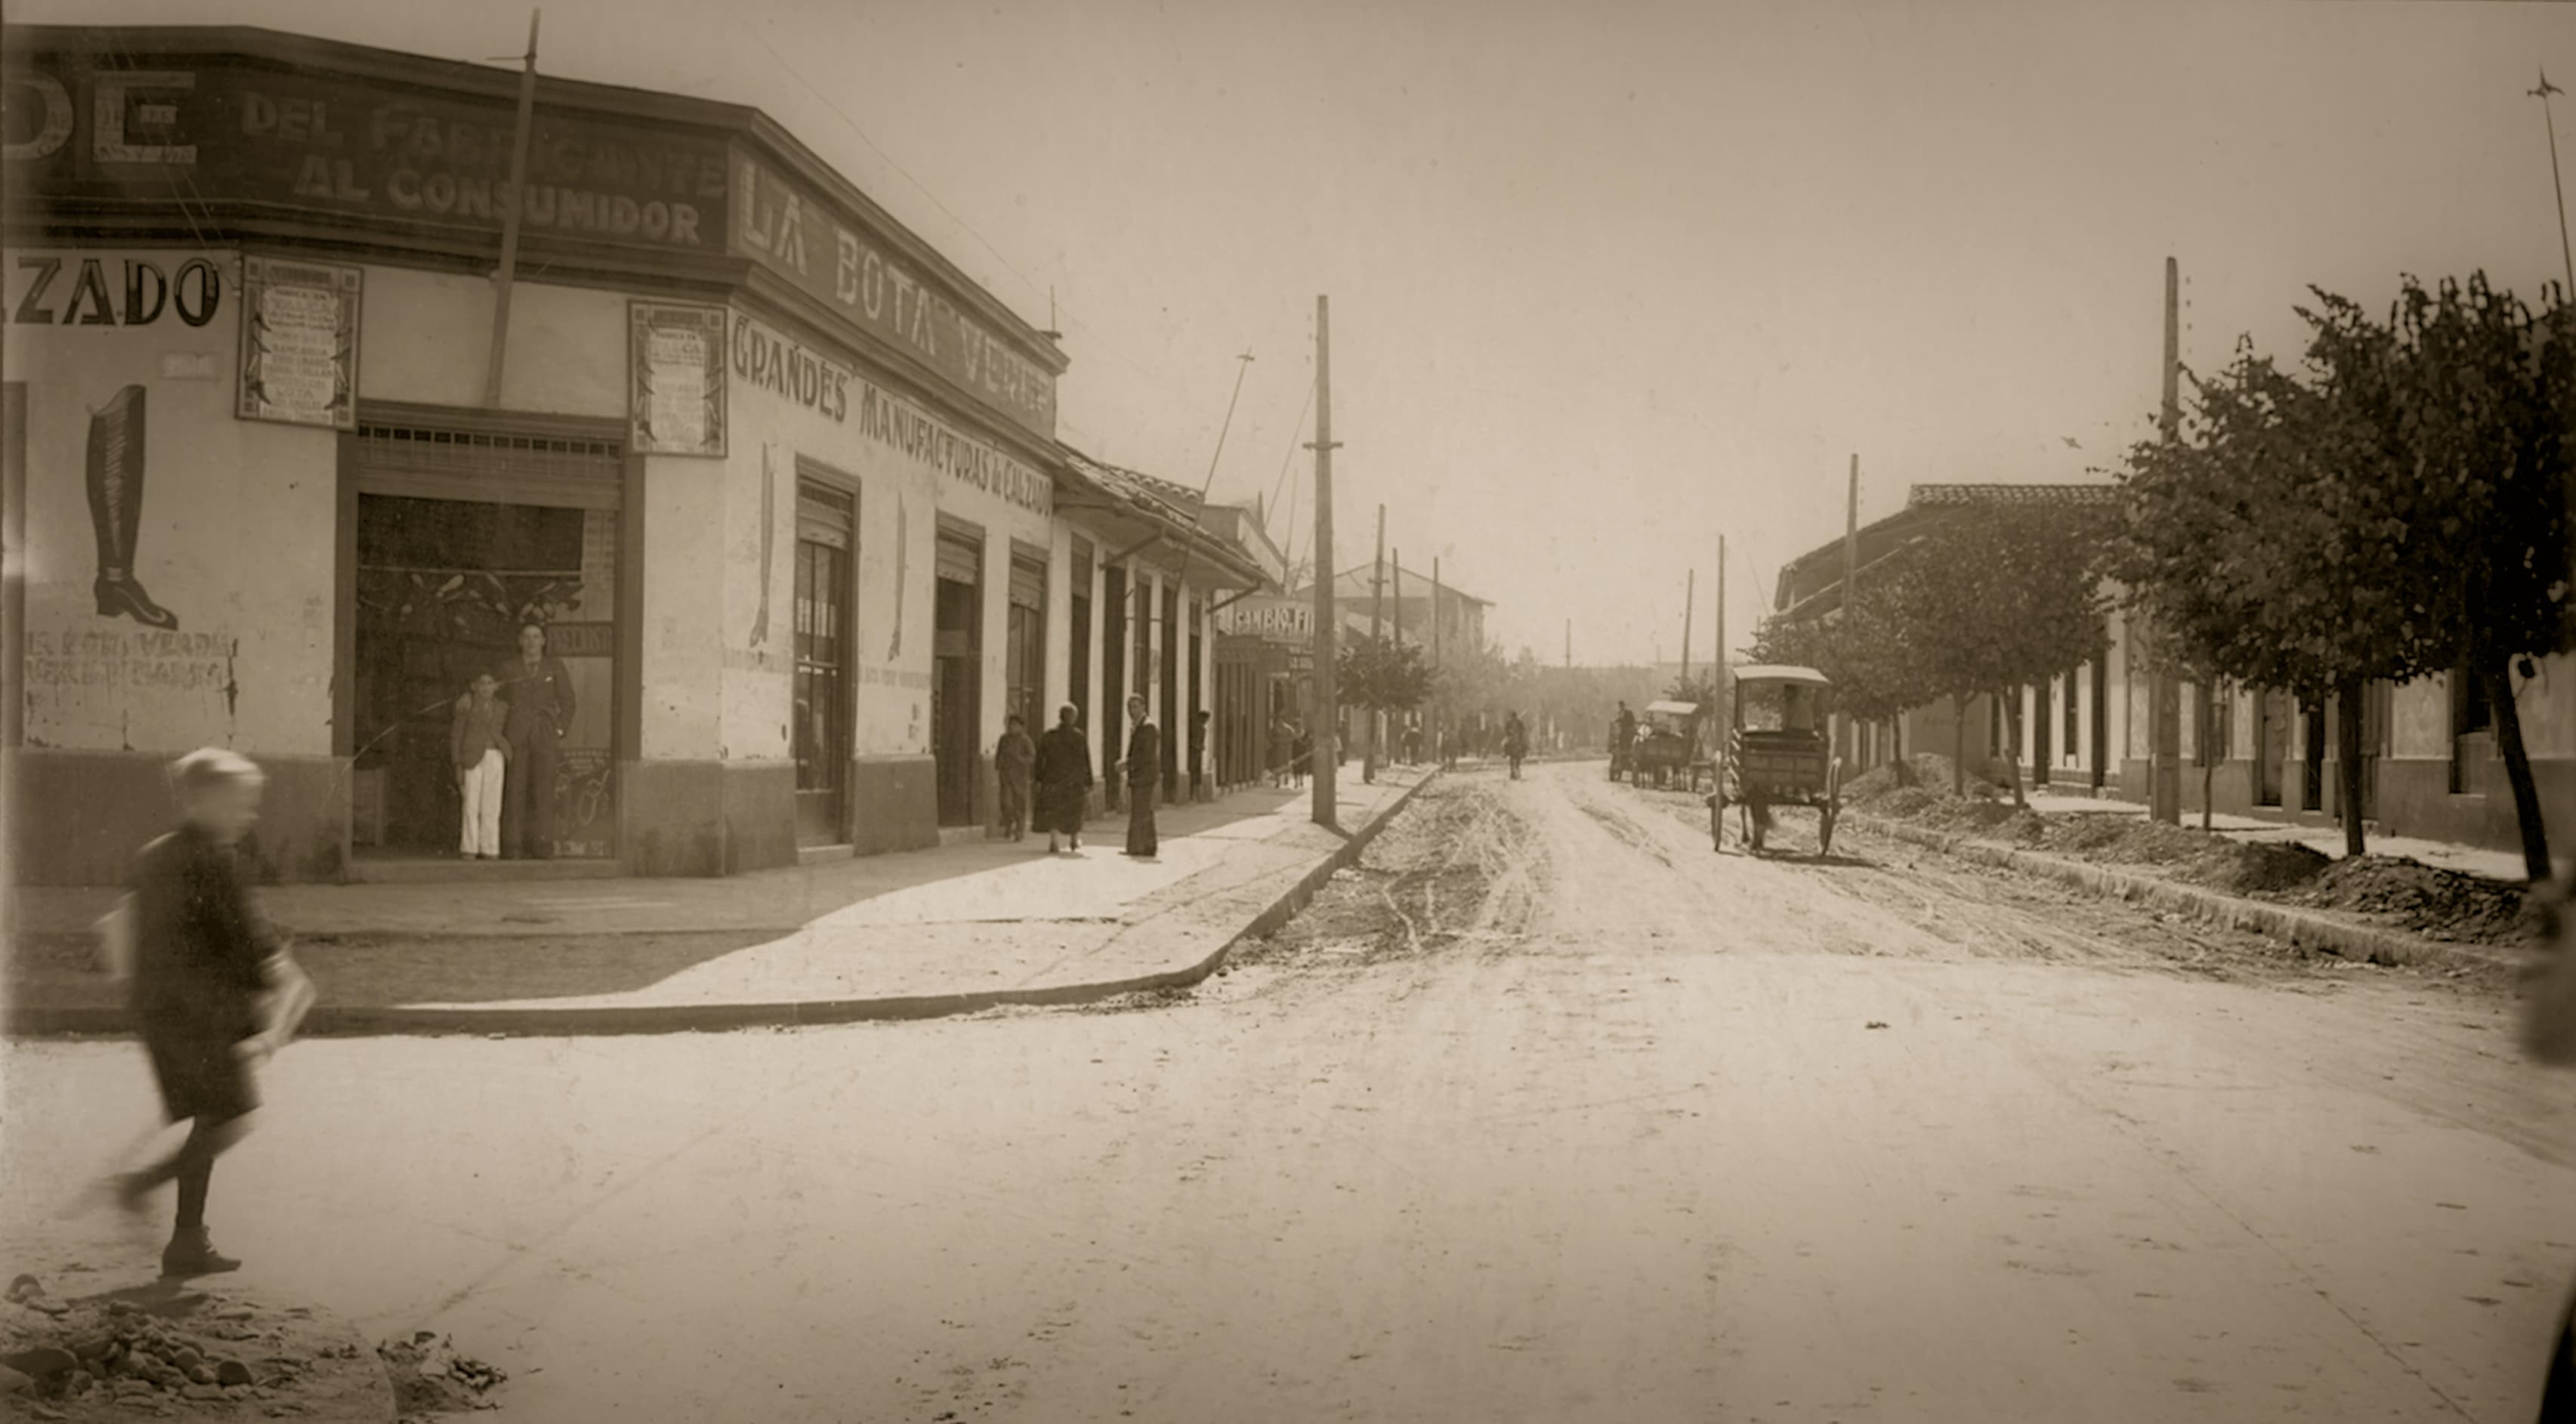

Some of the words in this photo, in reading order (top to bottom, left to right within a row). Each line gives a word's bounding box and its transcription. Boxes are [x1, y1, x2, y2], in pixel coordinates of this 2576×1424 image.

[242, 90, 344, 143] DEL
[370, 107, 727, 199] FABRICANTE
[292, 156, 370, 202] AL
[387, 168, 701, 246] CONSUMIDOR
[2, 257, 220, 327] ZADO
[738, 160, 808, 277] LA
[835, 227, 937, 357] BOTA
[732, 314, 848, 423] GRANDES
[860, 382, 988, 492] MANUFACTURAS
